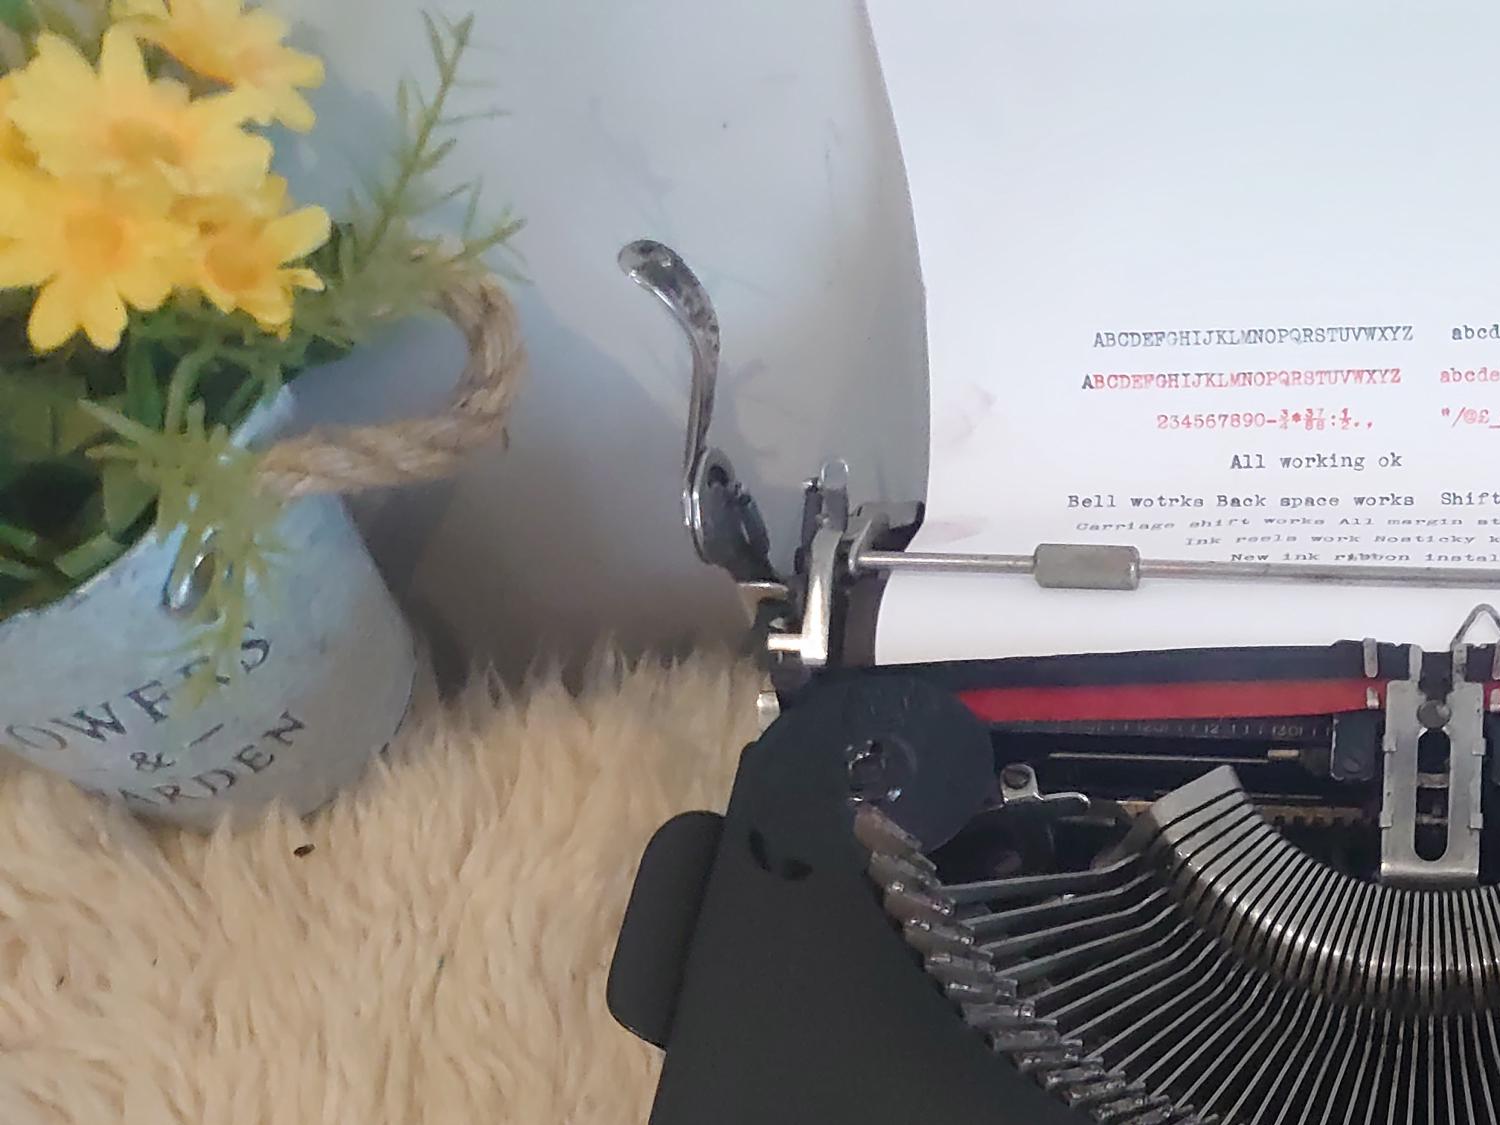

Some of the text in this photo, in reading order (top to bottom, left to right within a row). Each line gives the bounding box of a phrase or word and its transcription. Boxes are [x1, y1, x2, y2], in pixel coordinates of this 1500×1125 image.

[1093, 325, 1414, 348] ABCDEFGHIJKLMNOPQRSTUVWXYZ
[1081, 367, 1402, 390] ABCDEFGHIJKLMNOPQRSTUVWXYZ
[1230, 451, 1403, 472] All working ok
[1067, 494, 1117, 509] Bell
[1130, 494, 1204, 508] wotrks
[1216, 493, 1268, 508] Back
[1279, 496, 1340, 509] space
[1353, 492, 1415, 507] works
[1076, 521, 1176, 531] Carriage
[1189, 517, 1251, 528] shift
[1263, 517, 1326, 526] works
[1339, 517, 1375, 526] All
[1387, 518, 1463, 527] margin
[1235, 534, 1298, 544] reels
[1310, 535, 1361, 543] work
[1231, 553, 1270, 562] New
[1282, 552, 1321, 561] ink
